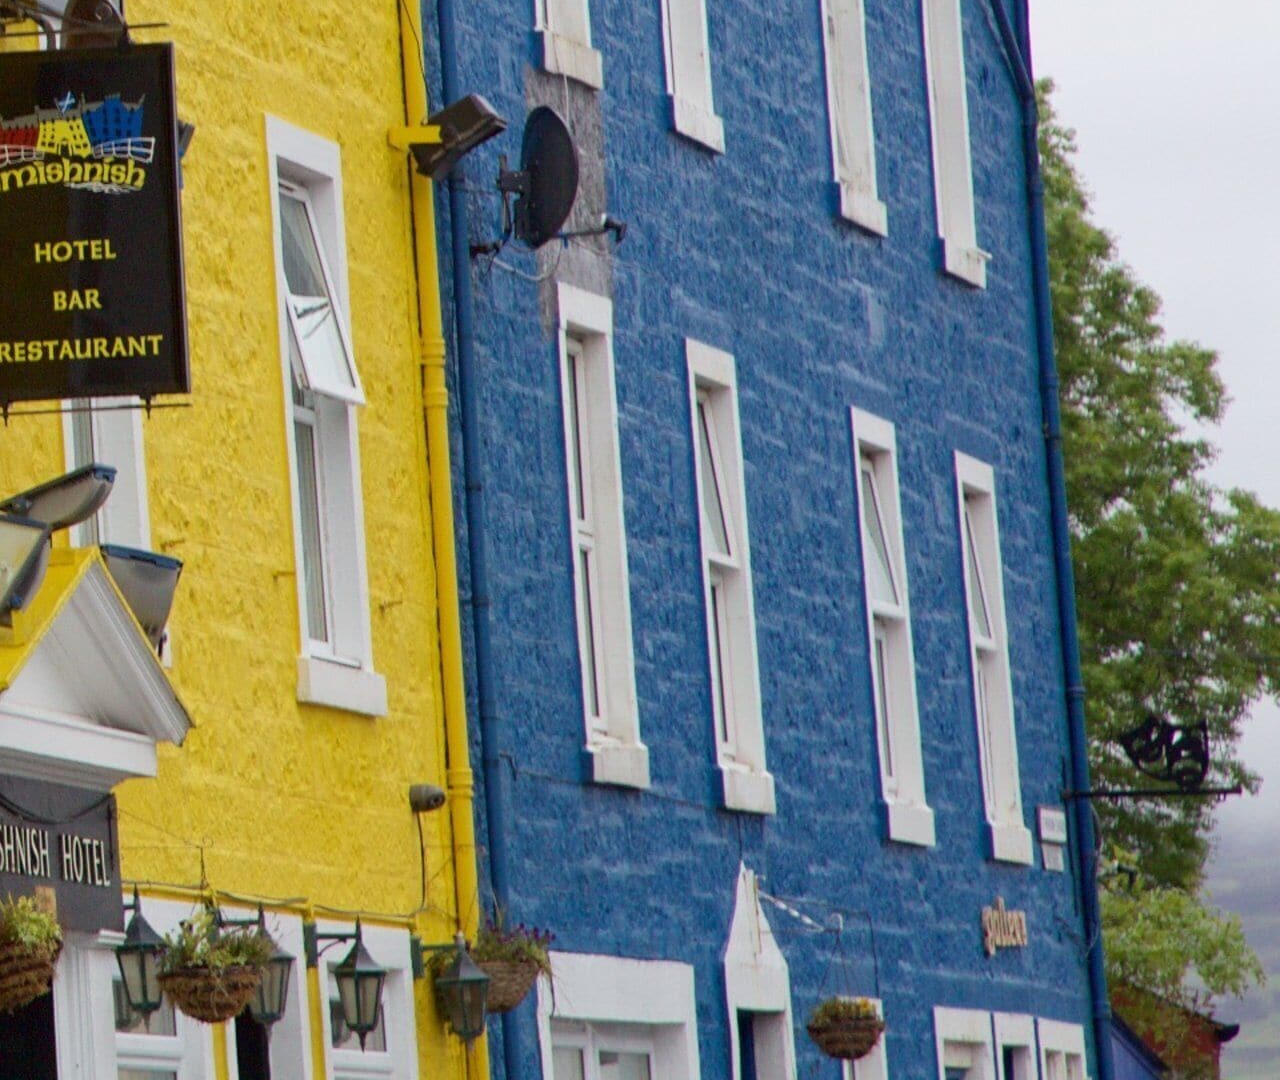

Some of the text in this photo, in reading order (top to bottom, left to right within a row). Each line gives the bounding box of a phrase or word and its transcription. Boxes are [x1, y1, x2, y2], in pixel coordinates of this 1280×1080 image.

[34, 239, 117, 264] HOTEL
[53, 289, 102, 312] BAR
[62, 833, 111, 887] HOTEL
